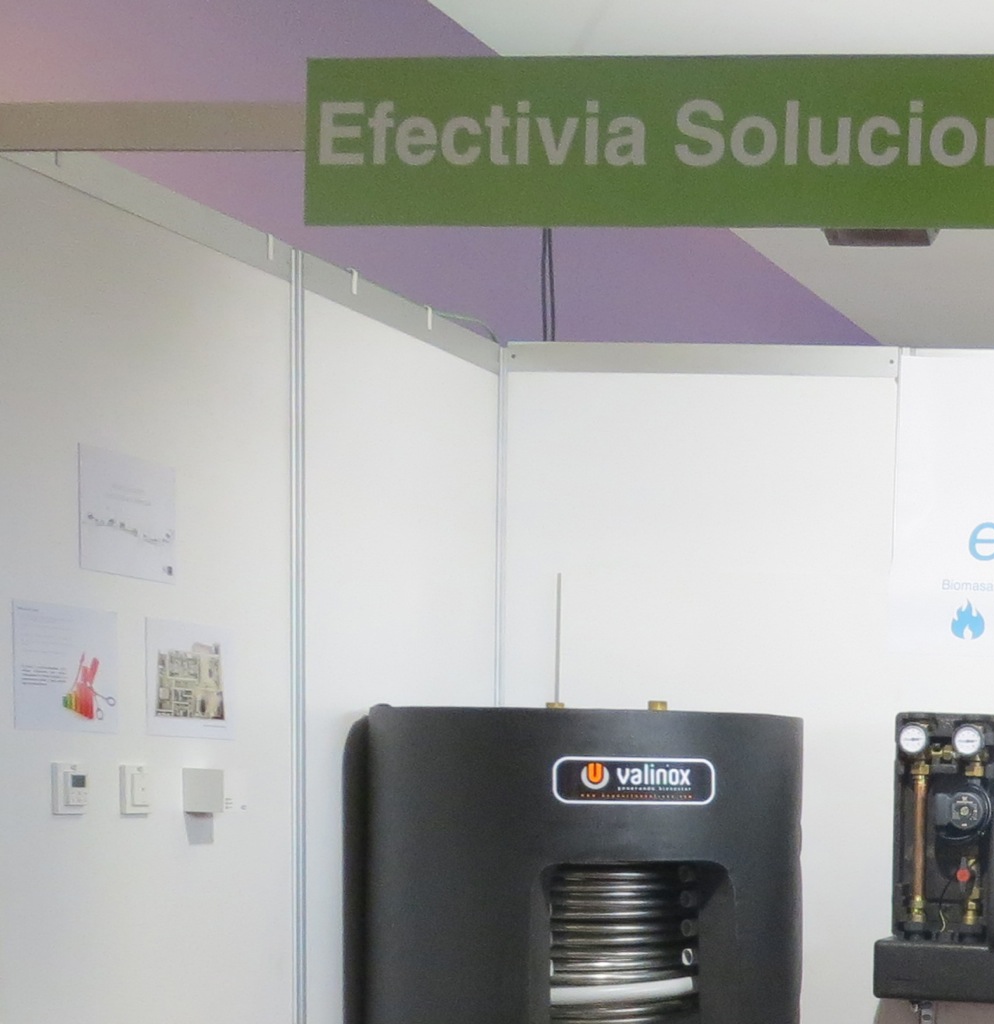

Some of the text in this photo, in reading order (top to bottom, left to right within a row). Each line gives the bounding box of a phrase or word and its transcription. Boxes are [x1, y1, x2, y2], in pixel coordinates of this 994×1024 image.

[317, 100, 646, 166] Efectivia
[941, 579, 994, 592] Biomasa
[616, 764, 691, 786] valinox
